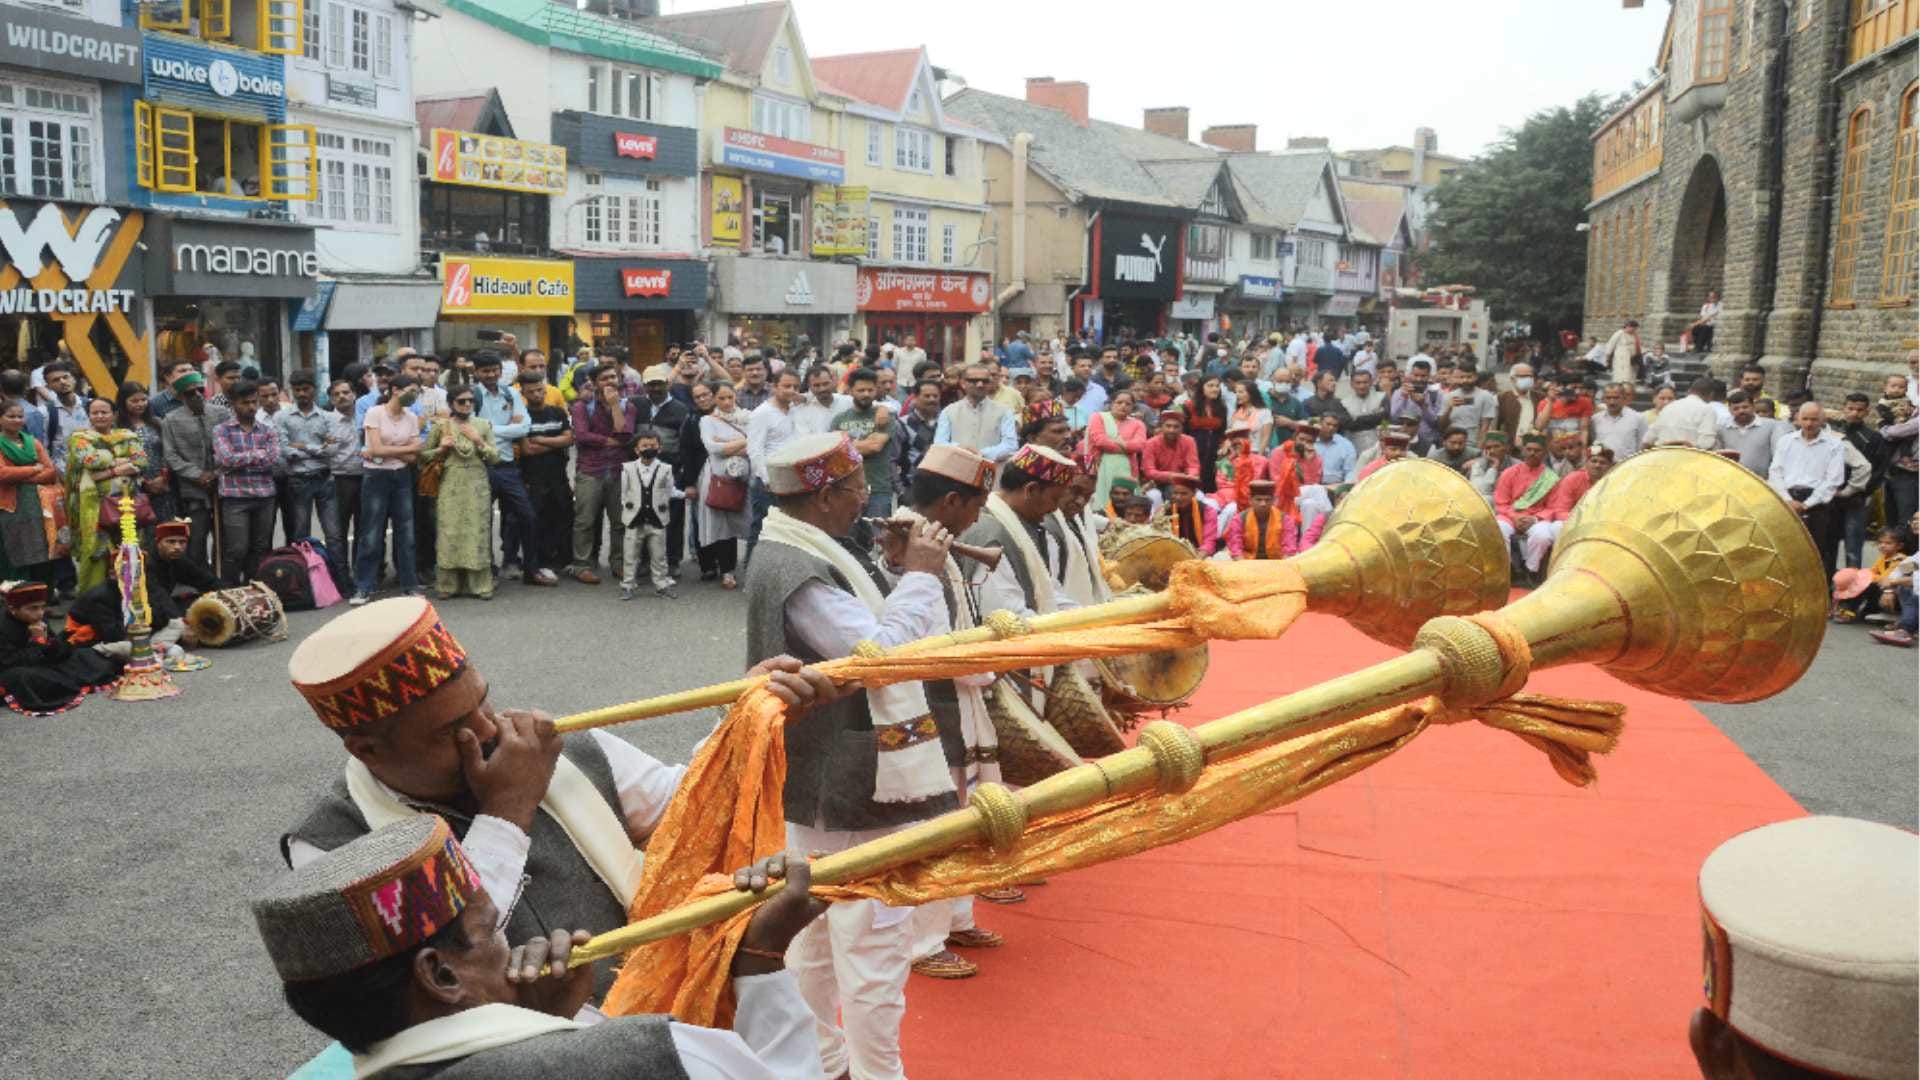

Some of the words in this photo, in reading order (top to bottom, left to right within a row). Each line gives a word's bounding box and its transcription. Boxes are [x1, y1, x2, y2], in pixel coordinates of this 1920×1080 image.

[7, 22, 138, 66] WILDCRAFT
[151, 57, 207, 83] wake
[239, 72, 283, 97] bake
[1115, 254, 1156, 282] PUMA
[0, 287, 135, 314] WILDCRAFT
[473, 277, 532, 295] Hideout
[537, 279, 569, 296] Cafe
